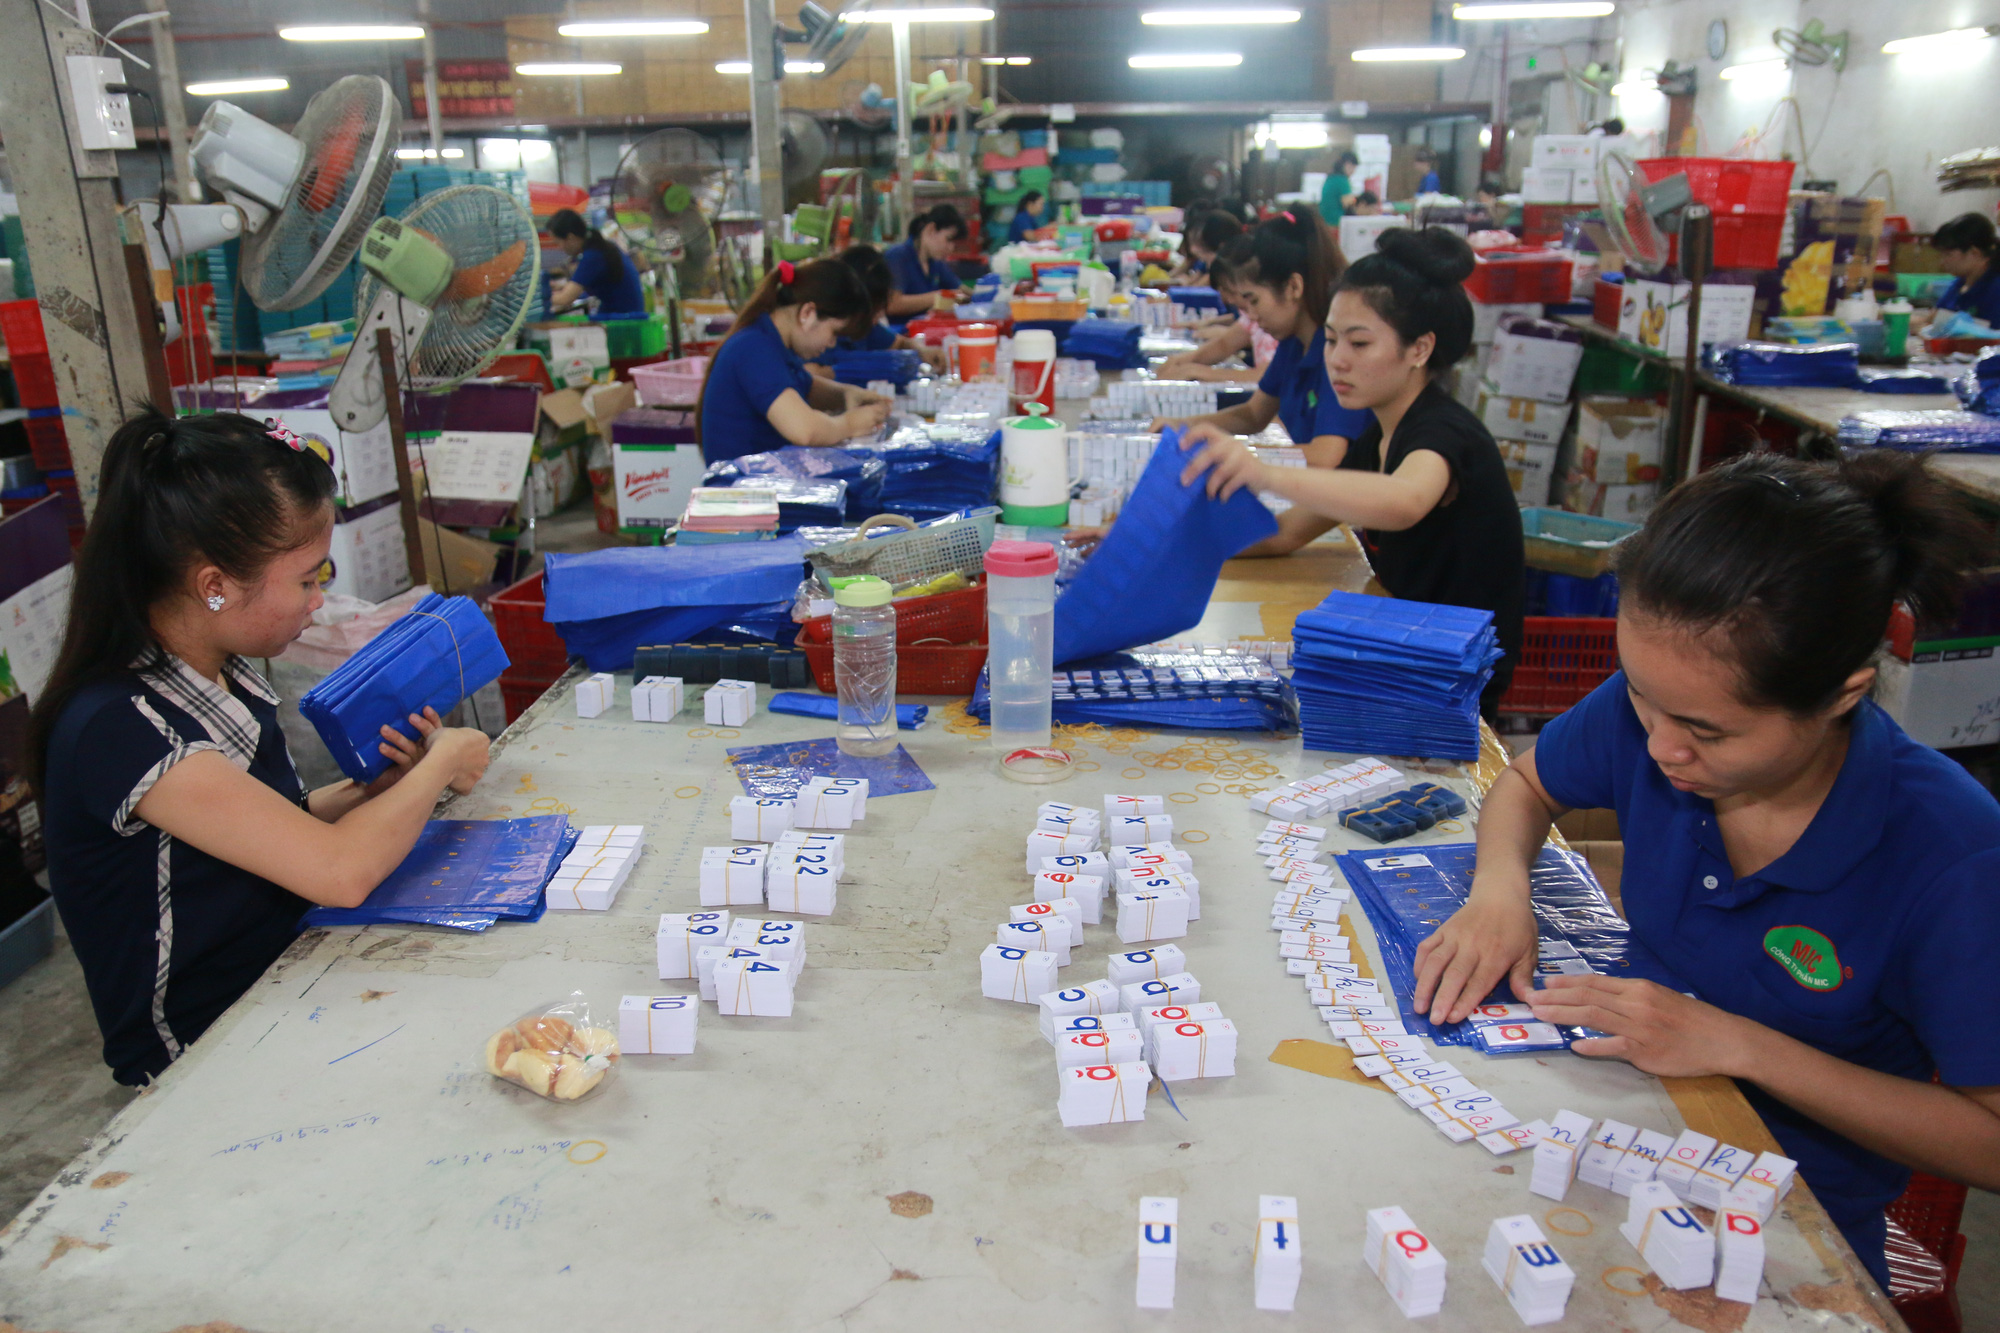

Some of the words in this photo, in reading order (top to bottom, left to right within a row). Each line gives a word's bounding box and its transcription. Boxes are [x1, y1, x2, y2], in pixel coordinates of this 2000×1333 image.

[755, 798, 783, 808] 5
[1045, 815, 1074, 824] k
[732, 846, 761, 855] 6
[1125, 846, 1148, 854] v
[728, 858, 756, 866] 7
[794, 854, 826, 864] 2
[1055, 855, 1088, 867] g
[797, 865, 829, 876] 2
[1130, 867, 1155, 877] u
[1043, 872, 1075, 883] ê
[1146, 878, 1170, 887] s
[1026, 904, 1051, 915] e
[686, 913, 720, 922] 8
[686, 925, 719, 935] 9
[761, 921, 793, 932] 3
[757, 934, 791, 945] 3
[728, 948, 761, 958] 4
[996, 945, 1028, 960] d
[1790, 939, 1822, 973] MIC
[746, 961, 780, 973] 4
[1770, 946, 1792, 965] CÔNG
[1814, 978, 1829, 987] MIC
[1141, 980, 1179, 996] p
[1058, 988, 1086, 1002] c
[650, 995, 688, 1010] 10
[1151, 1006, 1189, 1020] ô
[1066, 1016, 1102, 1031] b
[1174, 1022, 1204, 1037] o
[1498, 1024, 1529, 1041] a
[1071, 1032, 1110, 1047] â
[1076, 1065, 1117, 1081] ă
[1412, 1068, 1447, 1081] d
[1431, 1085, 1450, 1095] c
[1454, 1096, 1493, 1111] b
[1469, 1115, 1493, 1129] â
[1550, 1126, 1577, 1144] n
[1709, 1147, 1740, 1174] h
[1751, 1168, 1778, 1183] a
[1726, 1212, 1760, 1235] a
[1273, 1221, 1289, 1250] t
[1515, 1243, 1562, 1267] m
